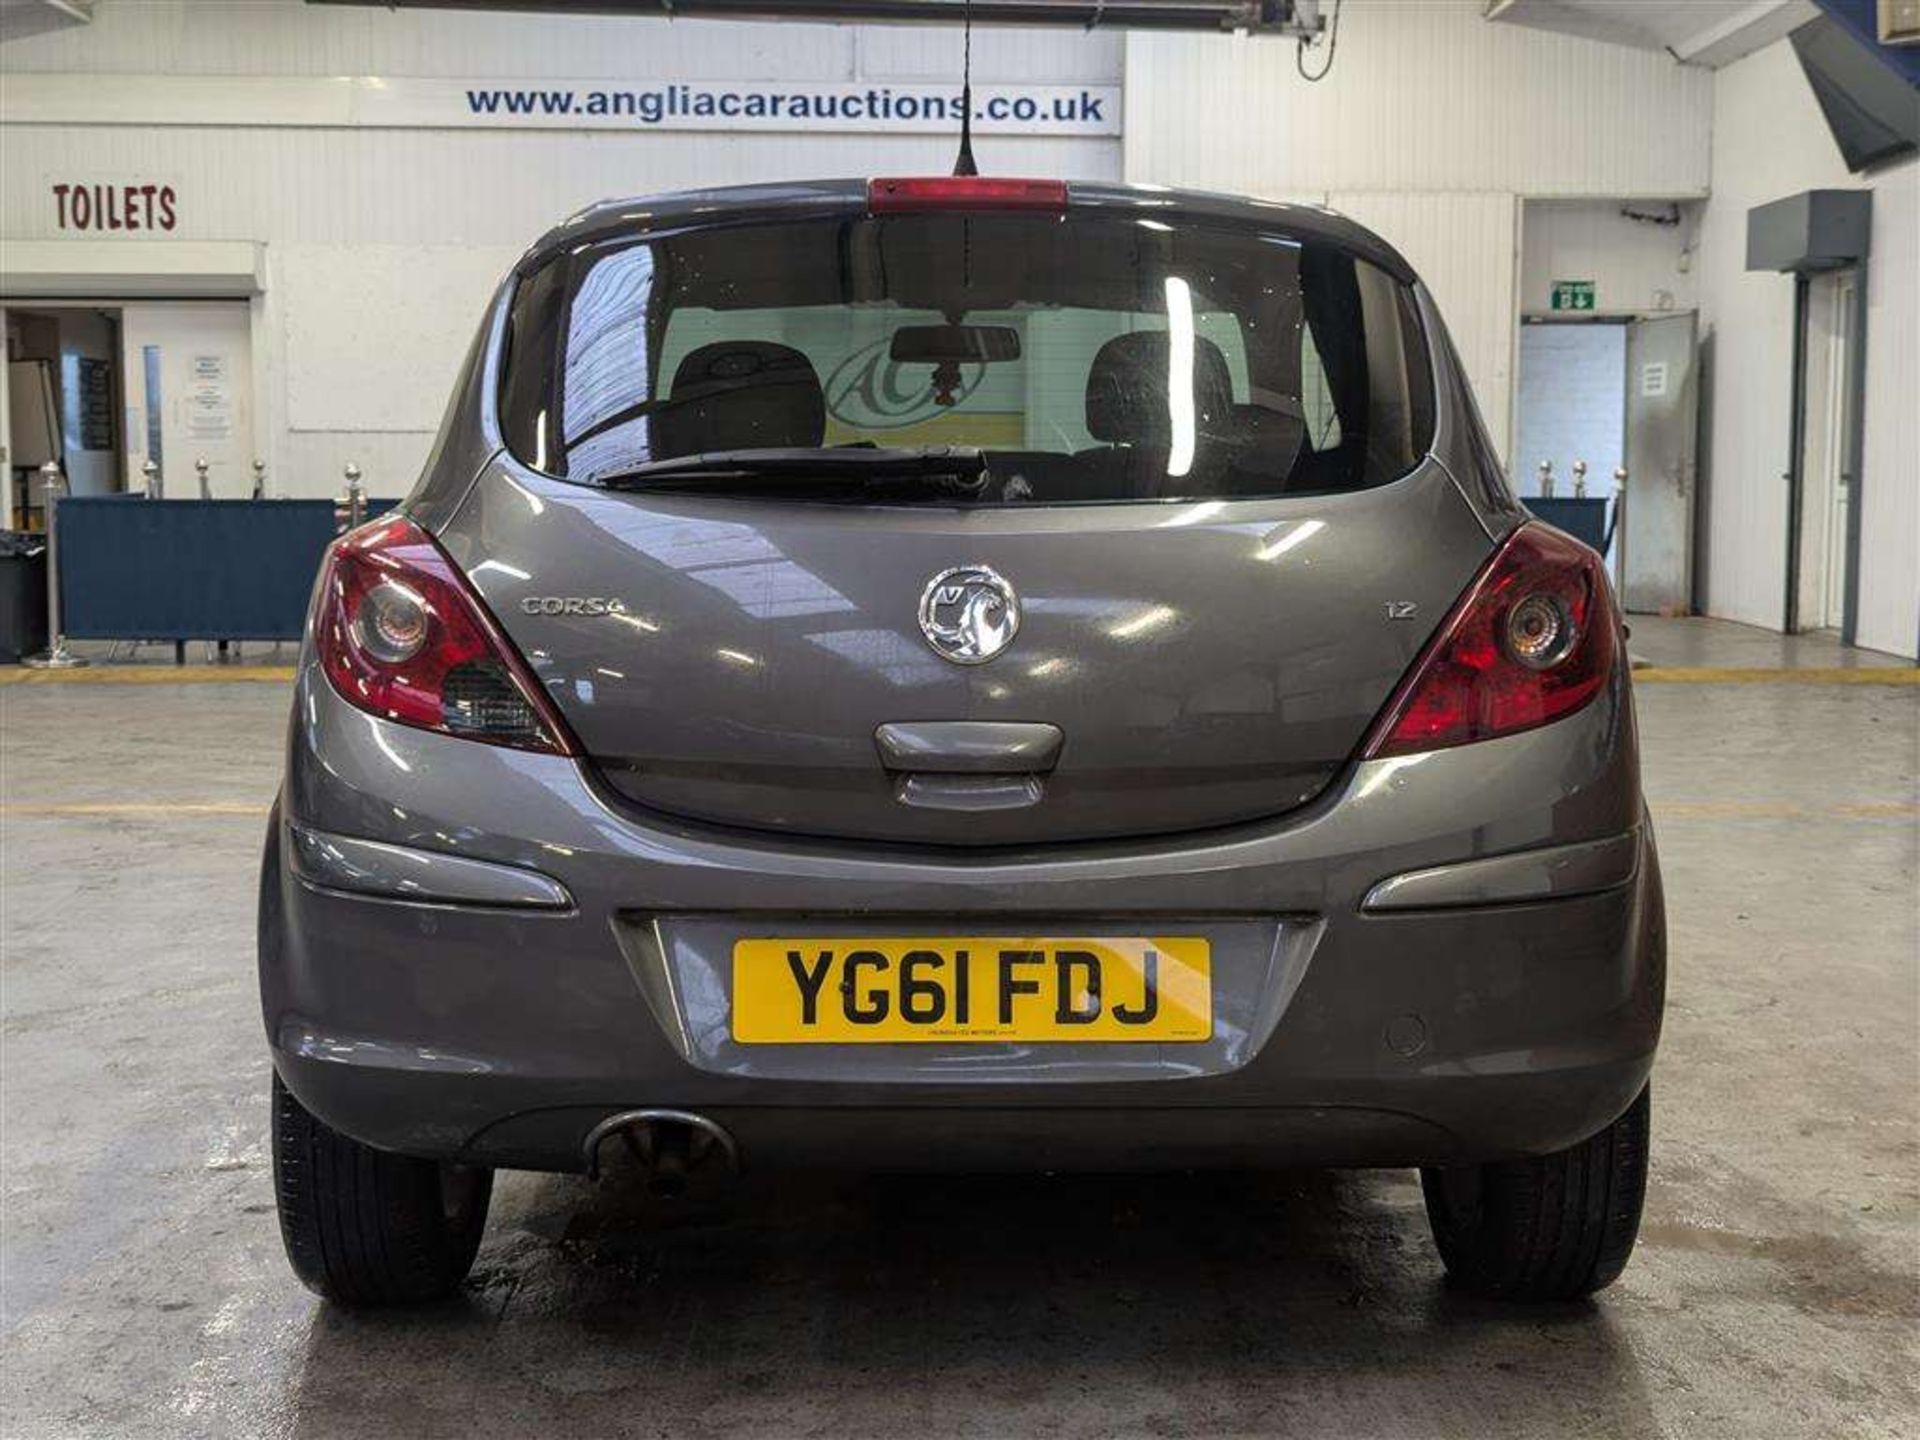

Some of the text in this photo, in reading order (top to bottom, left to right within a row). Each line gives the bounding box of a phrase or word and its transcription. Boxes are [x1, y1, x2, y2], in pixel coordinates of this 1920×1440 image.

[466, 85, 1103, 122] www.angliacarauctions.co.uk
[52, 184, 176, 231] TOILETS
[521, 597, 625, 615] CORSA
[787, 950, 1158, 1025] YG61 FDJ
